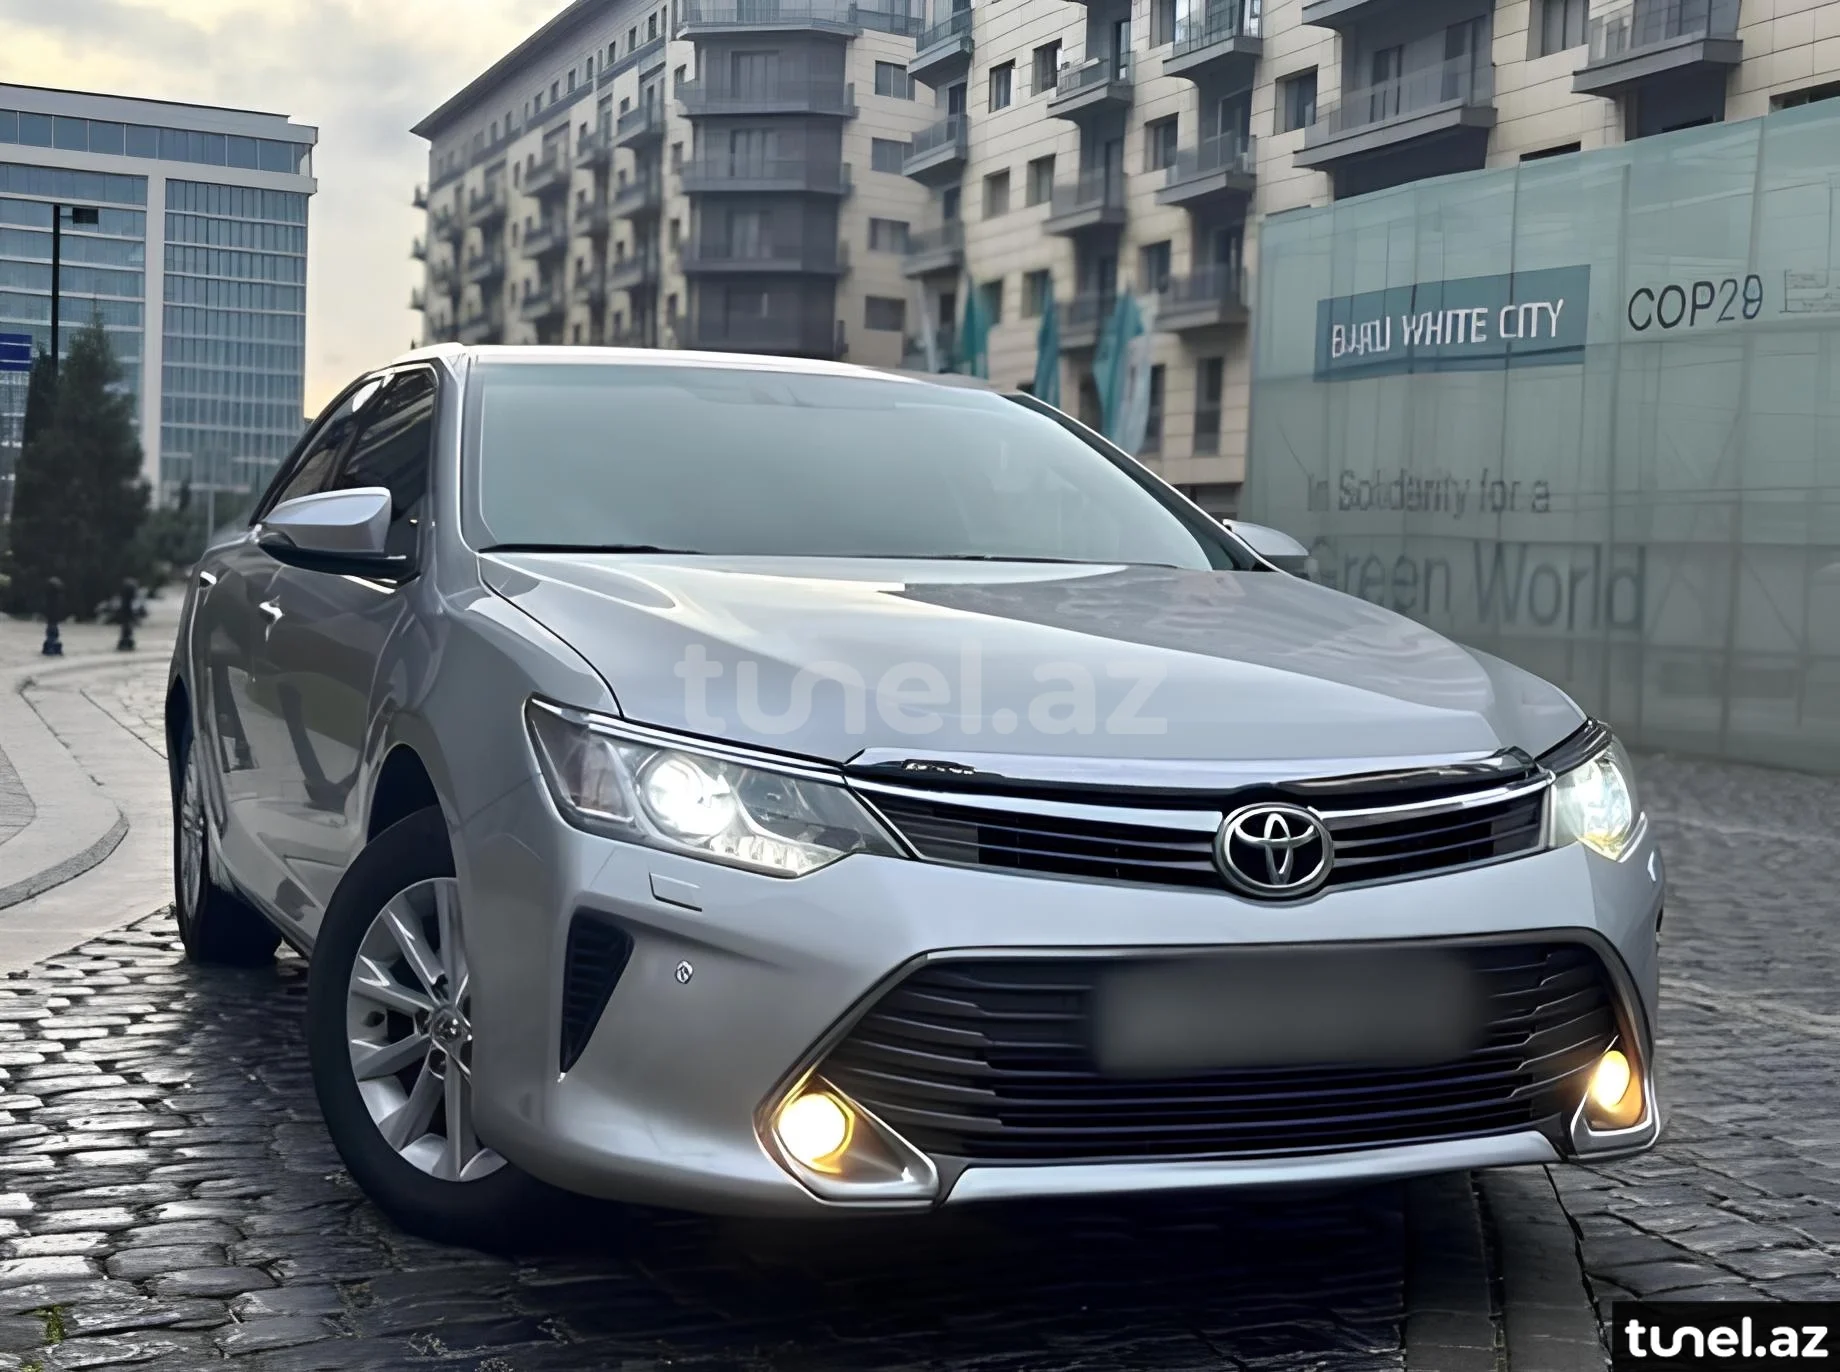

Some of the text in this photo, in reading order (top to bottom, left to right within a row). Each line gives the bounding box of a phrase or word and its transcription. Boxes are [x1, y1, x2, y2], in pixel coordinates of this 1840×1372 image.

[1402, 307, 1488, 346] WHITE
[1499, 298, 1564, 339] CITY
[1480, 468, 1522, 512] for
[1531, 479, 1550, 513] a
[1471, 539, 1646, 631] World
